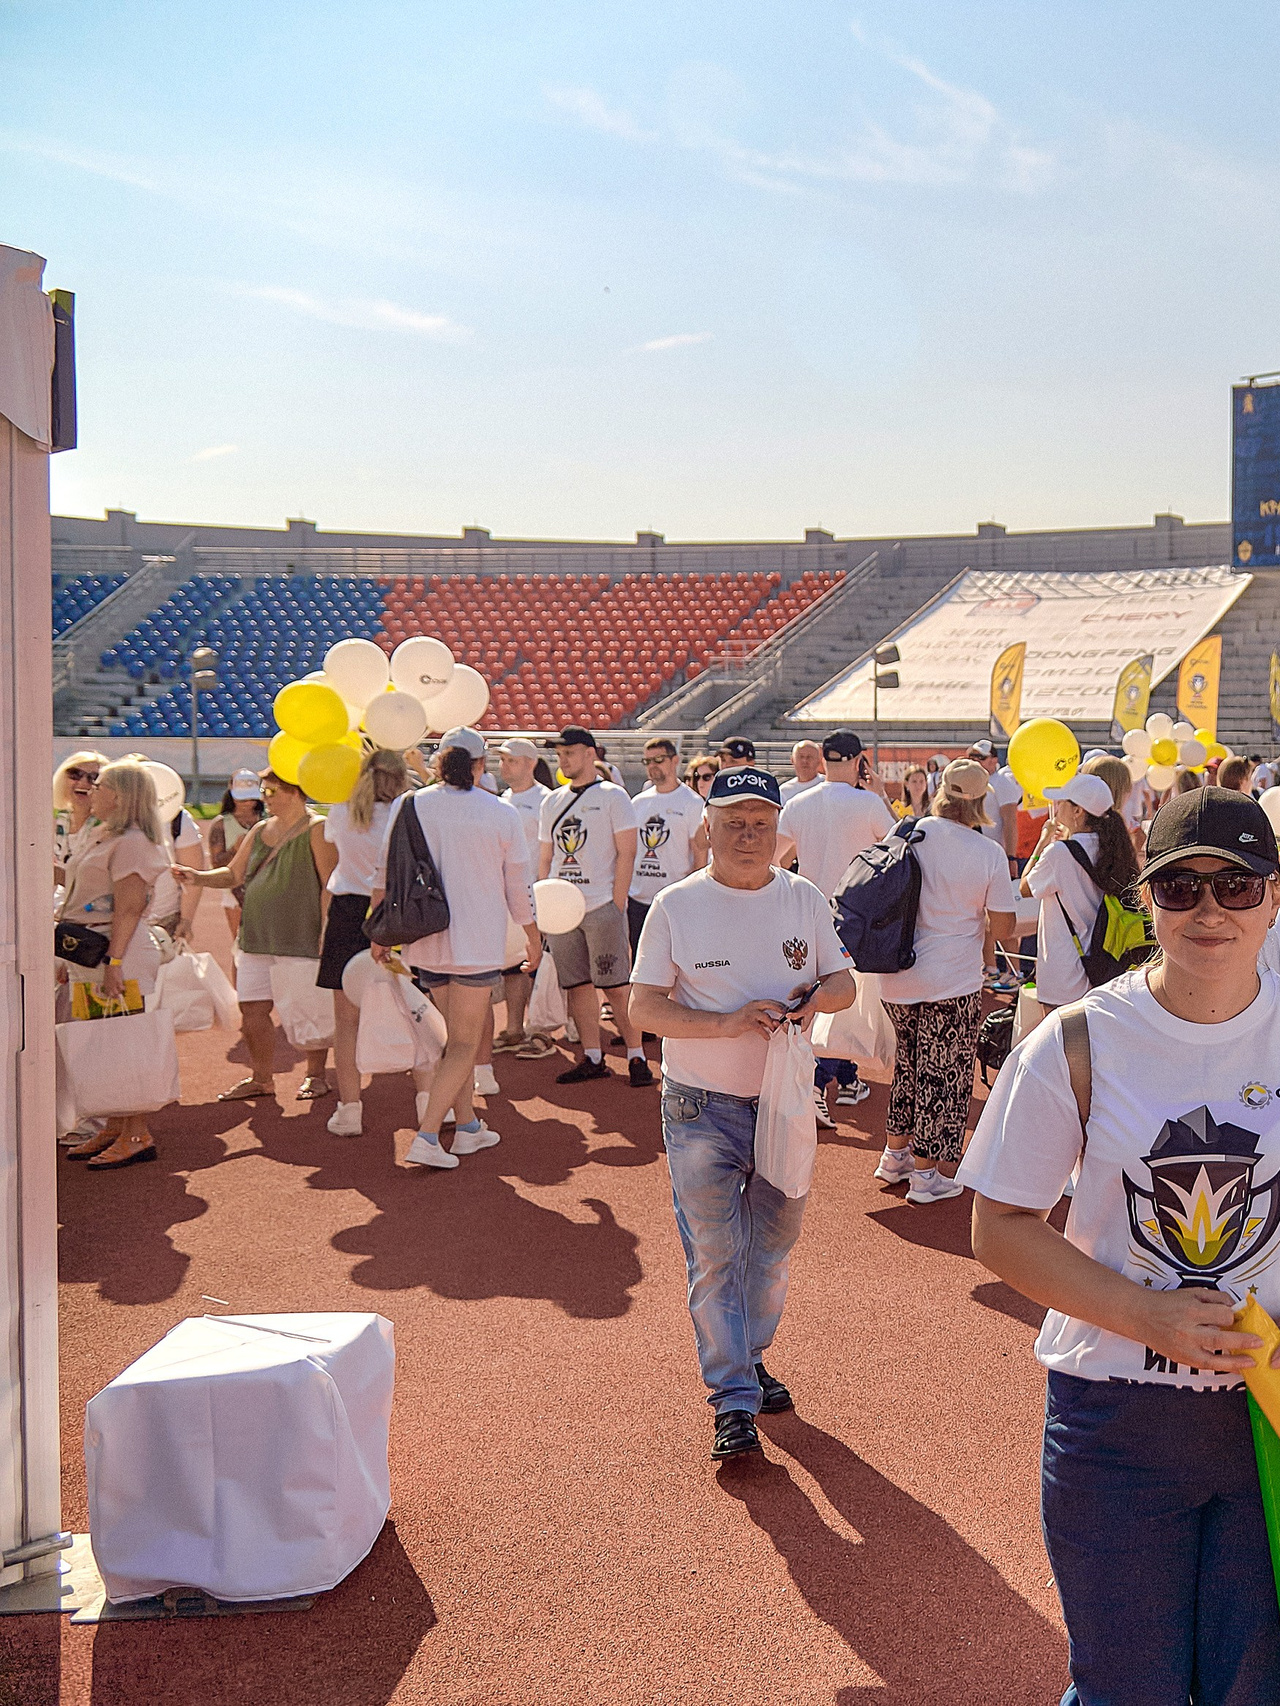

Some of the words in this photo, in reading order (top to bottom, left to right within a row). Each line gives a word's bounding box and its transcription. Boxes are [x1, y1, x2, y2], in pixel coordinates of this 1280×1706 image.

[1081, 609, 1193, 623] CHERY
[1024, 646, 1178, 659] DONGFENG
[726, 774, 768, 791] СУЭК
[641, 863, 661, 871] ИГРЫ
[558, 870, 583, 878] ИГРЫ
[636, 870, 668, 878] ТИТАНОВ
[694, 959, 731, 970] RUSSIA
